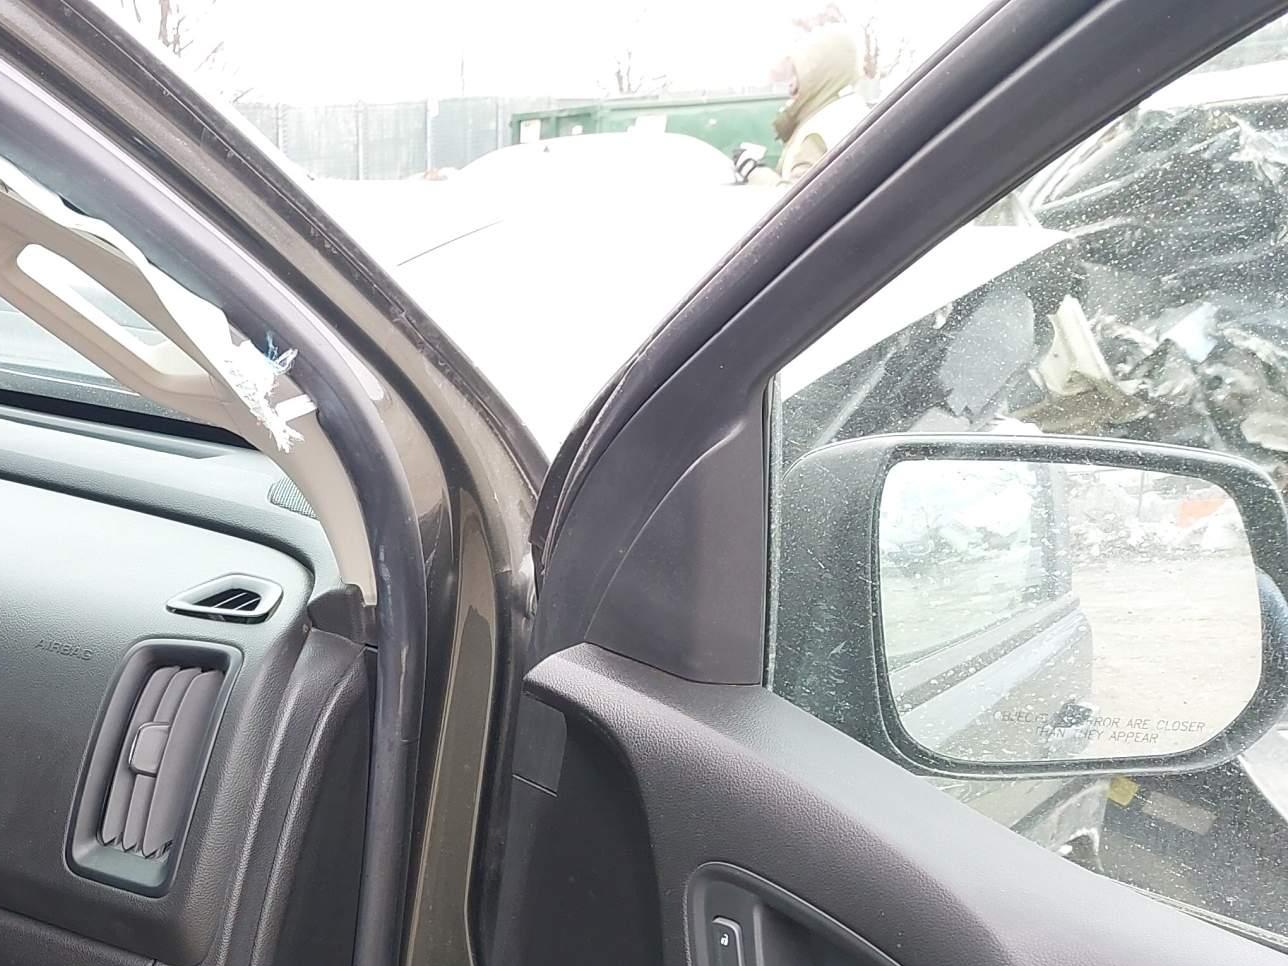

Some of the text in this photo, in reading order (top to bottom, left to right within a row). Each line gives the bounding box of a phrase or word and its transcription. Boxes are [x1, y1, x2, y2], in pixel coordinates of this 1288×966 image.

[34, 639, 93, 661] AIRBAG
[1126, 718, 1151, 730] ARE
[1156, 719, 1206, 733] CLOSER
[1110, 731, 1159, 744] APPEAR
